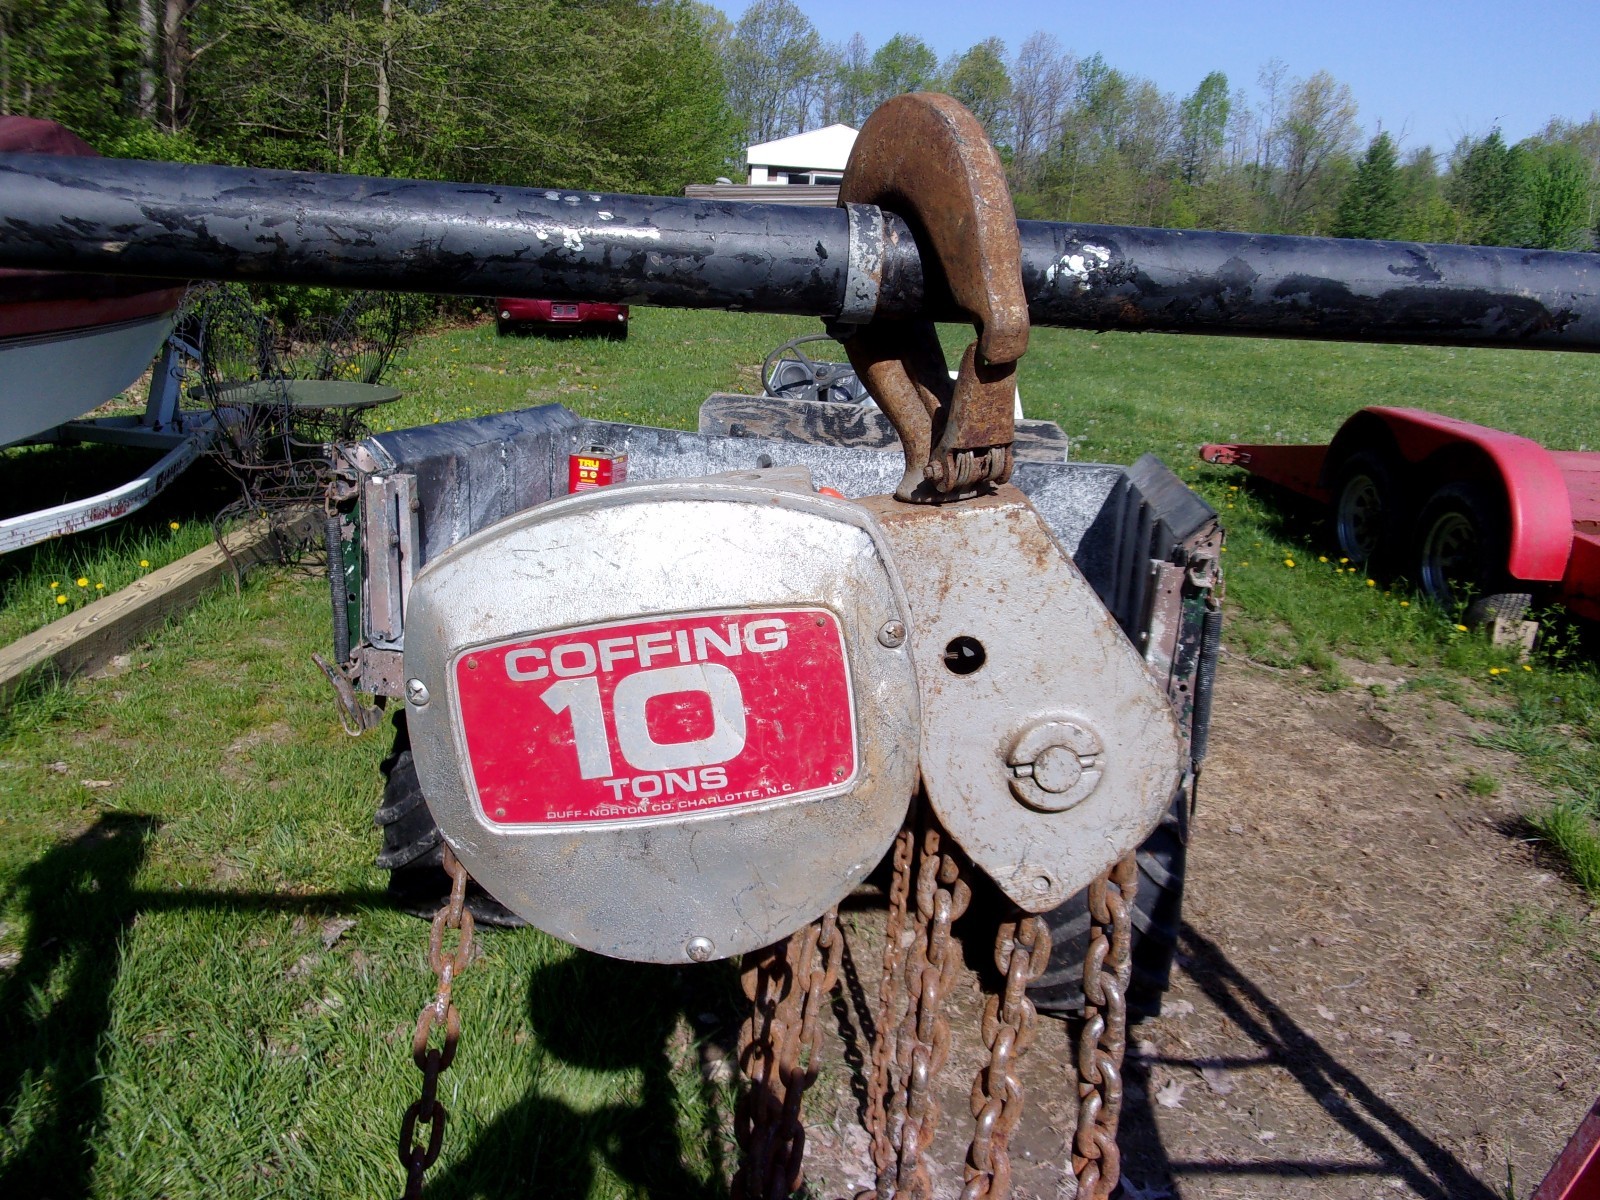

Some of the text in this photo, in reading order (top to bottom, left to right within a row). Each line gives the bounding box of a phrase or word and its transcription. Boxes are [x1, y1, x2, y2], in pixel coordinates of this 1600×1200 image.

[578, 458, 600, 468] TRU
[504, 618, 788, 682] COFFING
[538, 662, 746, 780] 10
[603, 767, 728, 801] TONS
[547, 805, 647, 820] DUFF-NORTON
[651, 803, 674, 812] CO.
[678, 788, 764, 808] CHARLOTTE,
